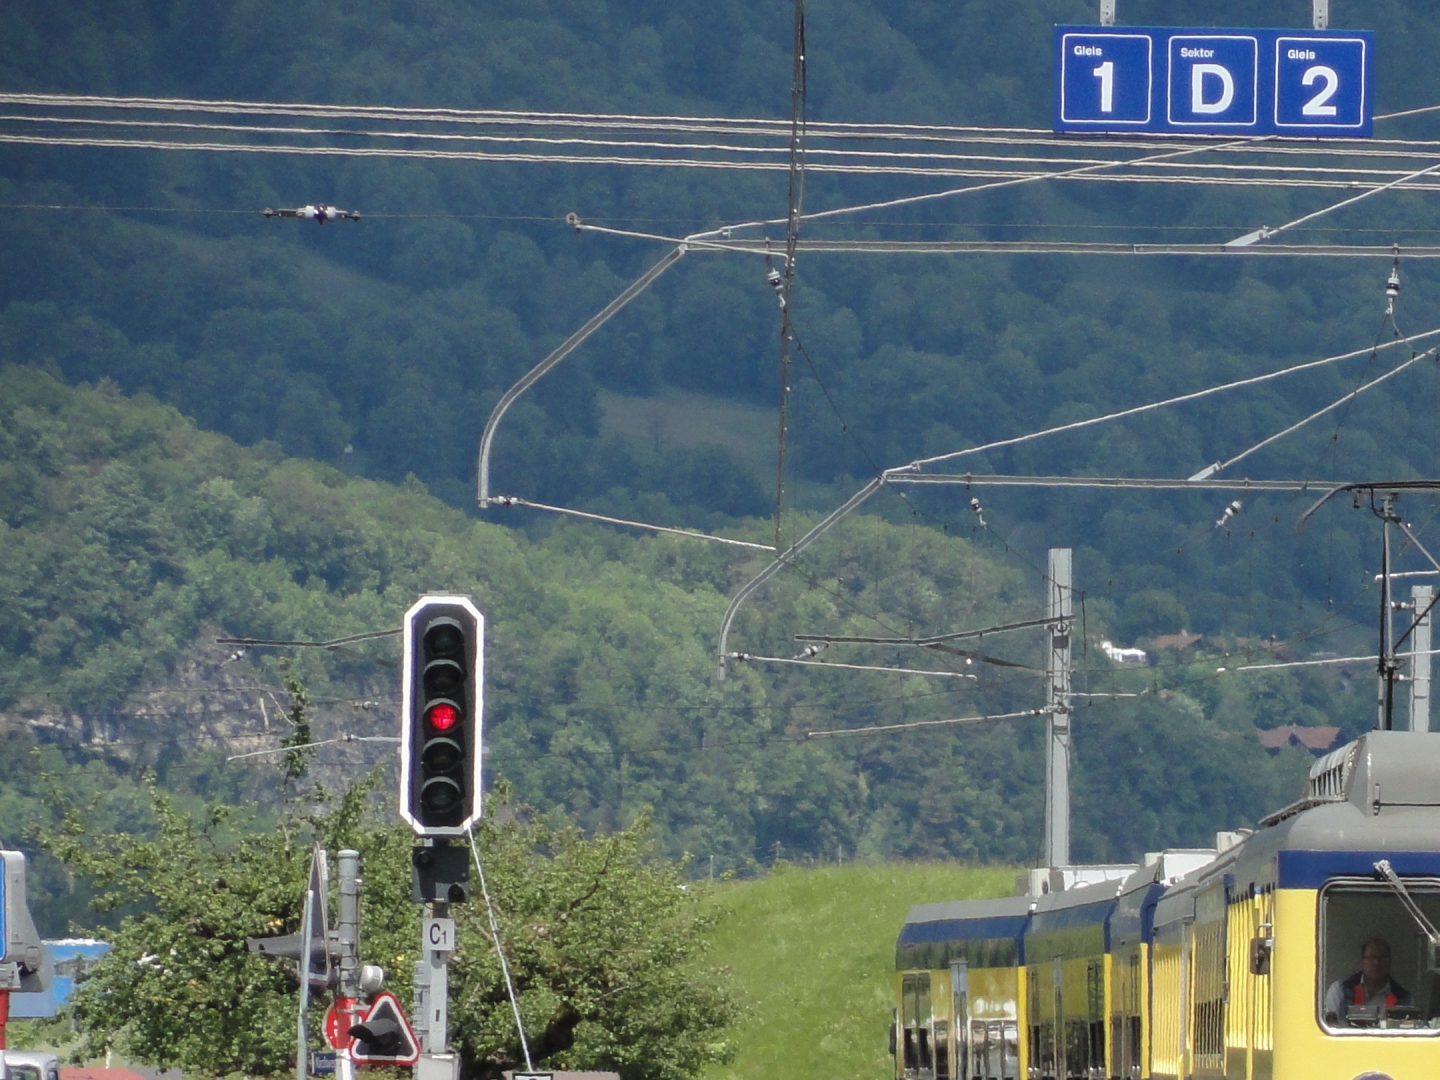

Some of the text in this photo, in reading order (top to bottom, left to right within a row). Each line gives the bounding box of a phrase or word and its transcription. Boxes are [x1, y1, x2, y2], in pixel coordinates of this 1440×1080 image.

[1073, 46, 1102, 56] Gleis
[1180, 47, 1214, 58] Sektor
[1287, 49, 1316, 59] Gleis
[1093, 61, 1114, 112] 1
[1191, 63, 1235, 113] D
[1301, 65, 1339, 116] 2
[429, 923, 447, 945] C1
